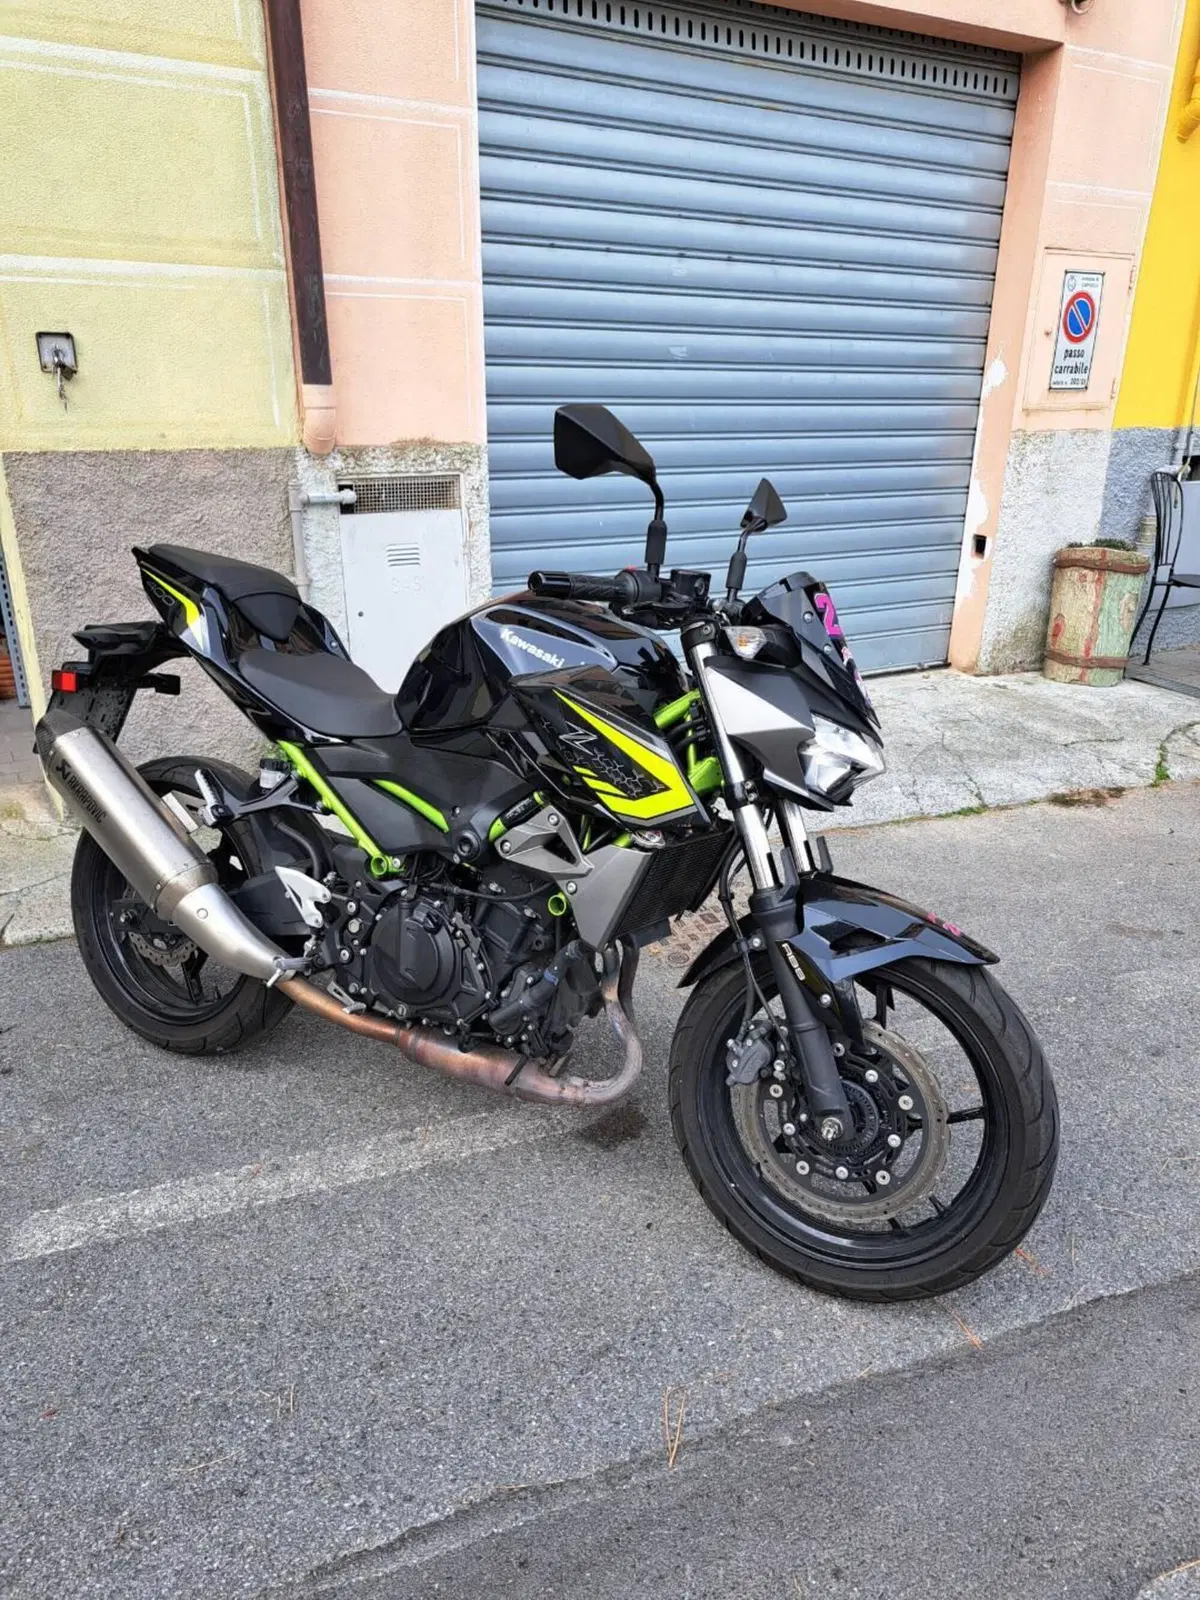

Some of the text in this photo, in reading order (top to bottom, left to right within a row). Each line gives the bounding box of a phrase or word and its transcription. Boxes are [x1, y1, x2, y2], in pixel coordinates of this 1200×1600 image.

[1063, 349, 1085, 361] passo
[1054, 362, 1088, 374] carrabile
[500, 629, 565, 668] Kawasaki
[781, 943, 806, 981] ABS
